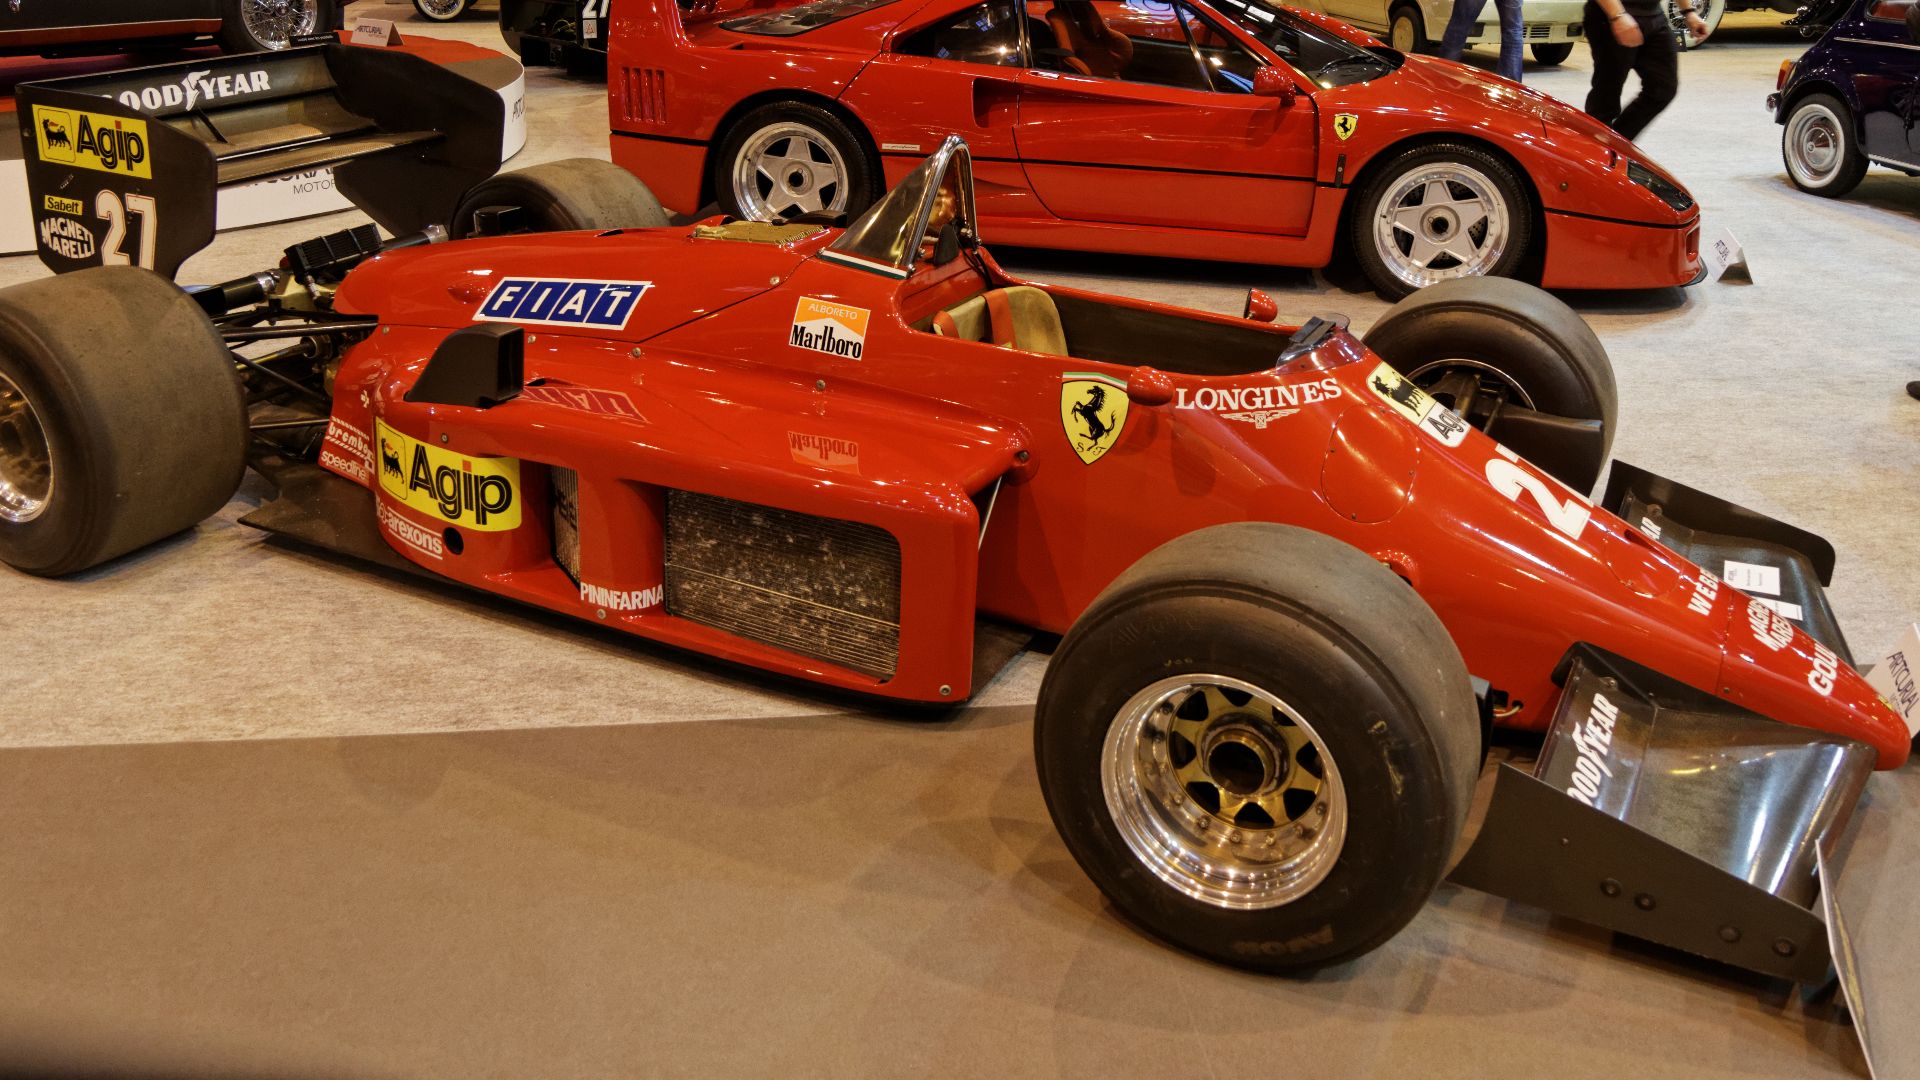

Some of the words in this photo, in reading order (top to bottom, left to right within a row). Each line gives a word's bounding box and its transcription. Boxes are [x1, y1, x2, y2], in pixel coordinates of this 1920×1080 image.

[101, 70, 271, 112] OODYEAR
[77, 115, 145, 171] Agip
[47, 197, 80, 214] Sabelt
[40, 217, 95, 243] MAGNETI
[40, 234, 95, 259] MARELLI
[96, 189, 158, 271] 27
[492, 286, 633, 318] FIAT
[808, 303, 858, 320] ALBORETO
[790, 324, 862, 358] Marlboro
[1175, 378, 1343, 411] LONGINES
[328, 421, 369, 454] brembo
[320, 450, 367, 480] speedline
[409, 443, 512, 525] Agip
[387, 512, 442, 555] arexons
[580, 581, 664, 611] PININFARINA
[1886, 651, 1919, 718] ARTCURIAL
[1566, 692, 1619, 807] OODYEAR
